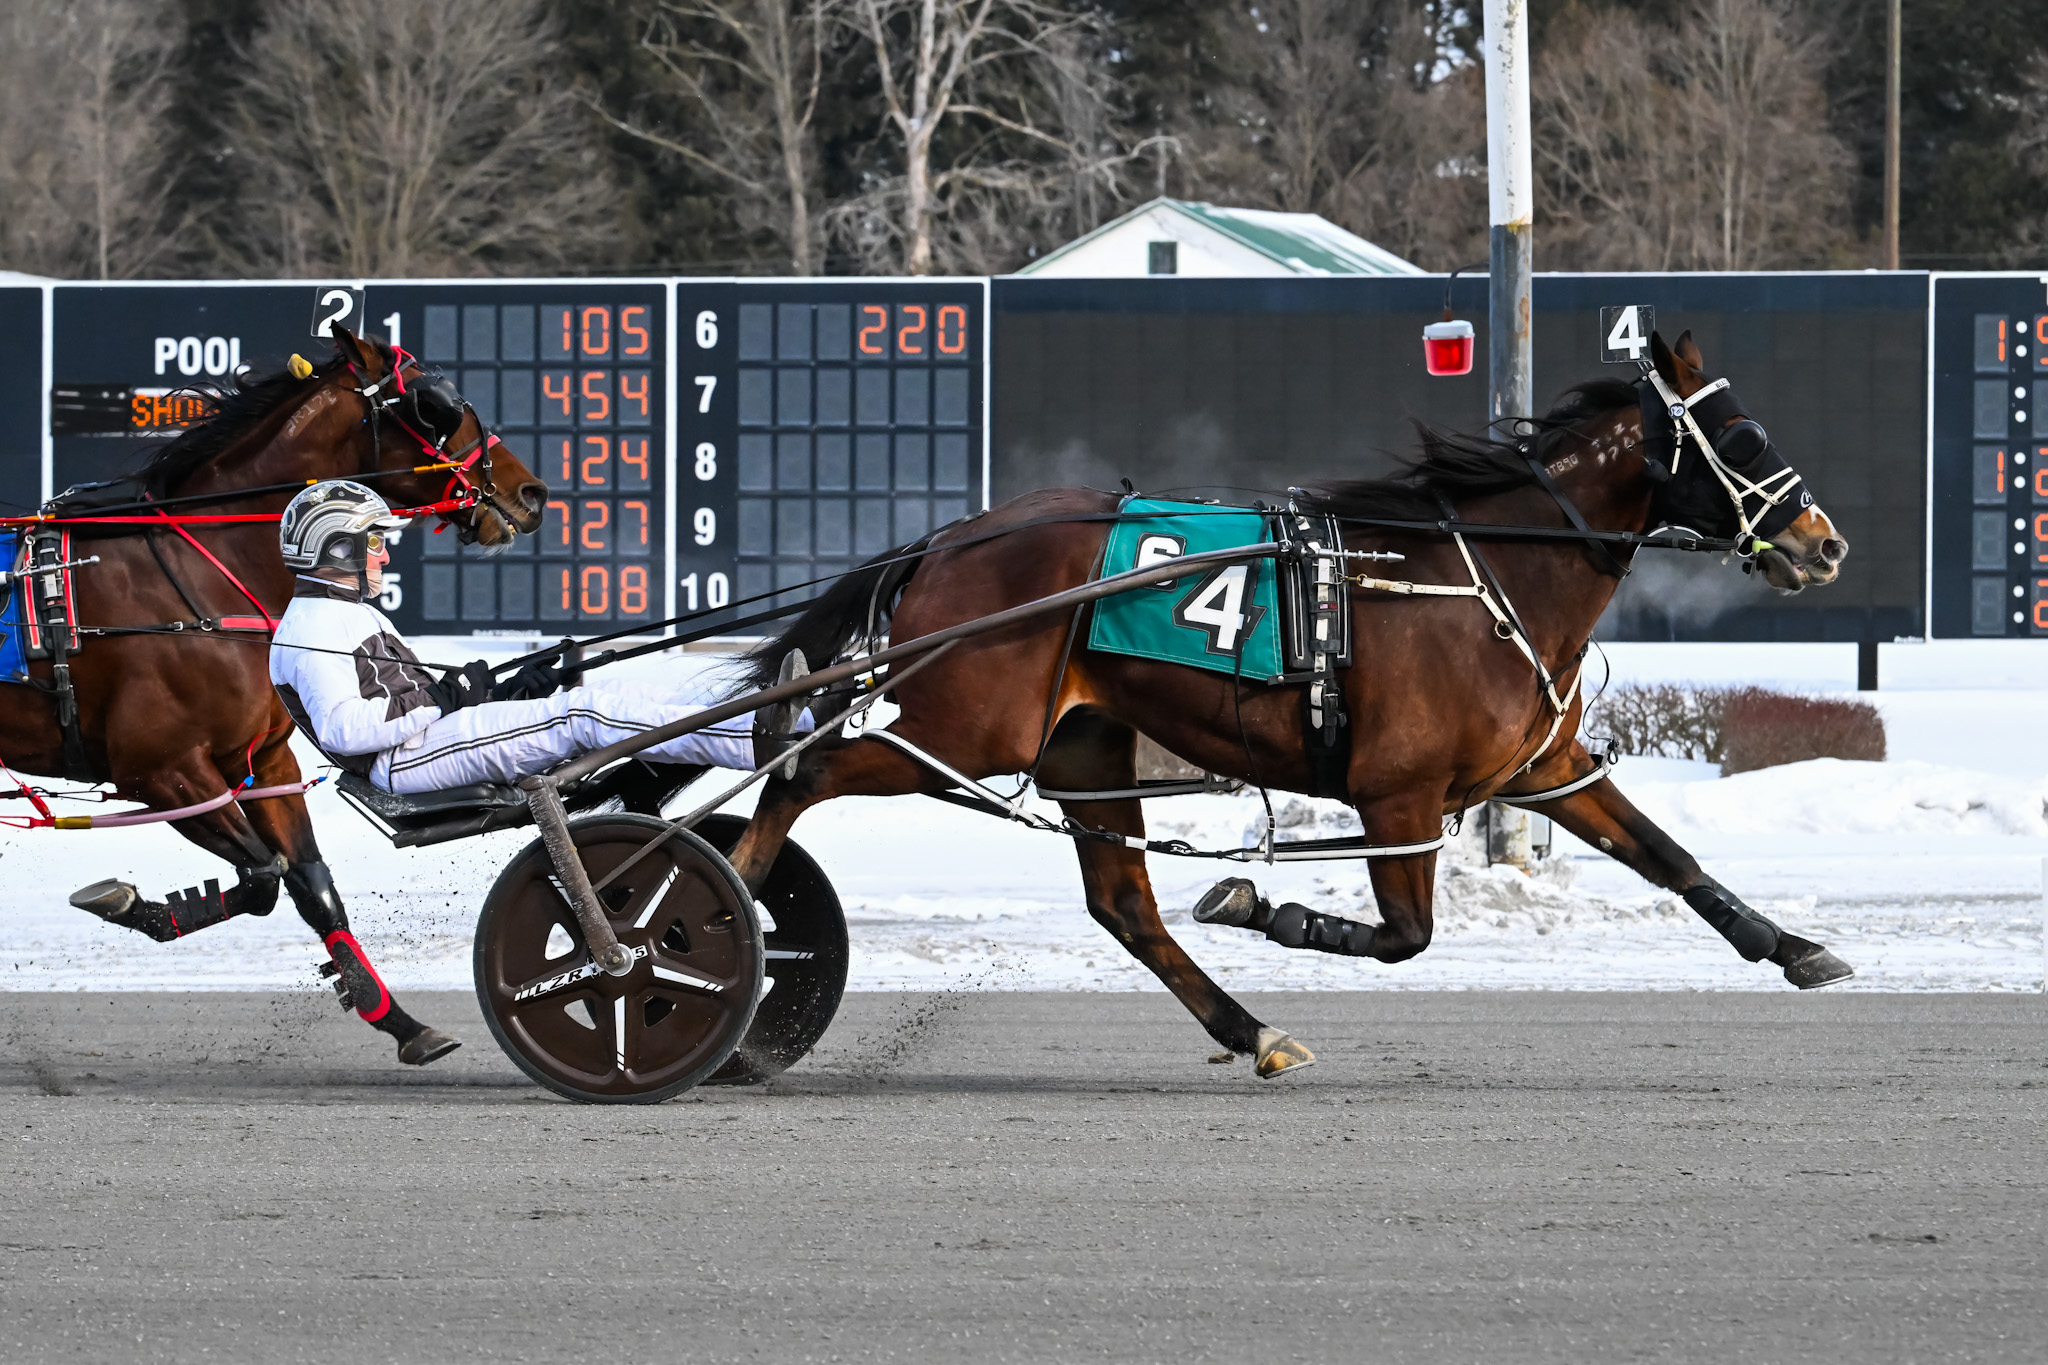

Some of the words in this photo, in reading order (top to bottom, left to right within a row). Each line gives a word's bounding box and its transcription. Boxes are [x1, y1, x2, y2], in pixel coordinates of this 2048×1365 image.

[317, 289, 354, 338] 2
[383, 311, 401, 347] 1
[564, 306, 649, 355] 105
[695, 310, 718, 349] 6
[859, 306, 966, 354] 220
[1608, 305, 1648, 359] 4
[154, 336, 251, 376] POOL
[543, 372, 648, 420] 454
[694, 376, 717, 414] 7
[562, 436, 648, 485] 124
[694, 442, 717, 481] 8
[545, 500, 648, 549] 727
[693, 507, 716, 546] 9
[380, 572, 403, 611] 5
[562, 566, 647, 614] 108
[680, 572, 729, 611] 10
[1183, 564, 1250, 651] 4
[532, 967, 584, 997] LZR
